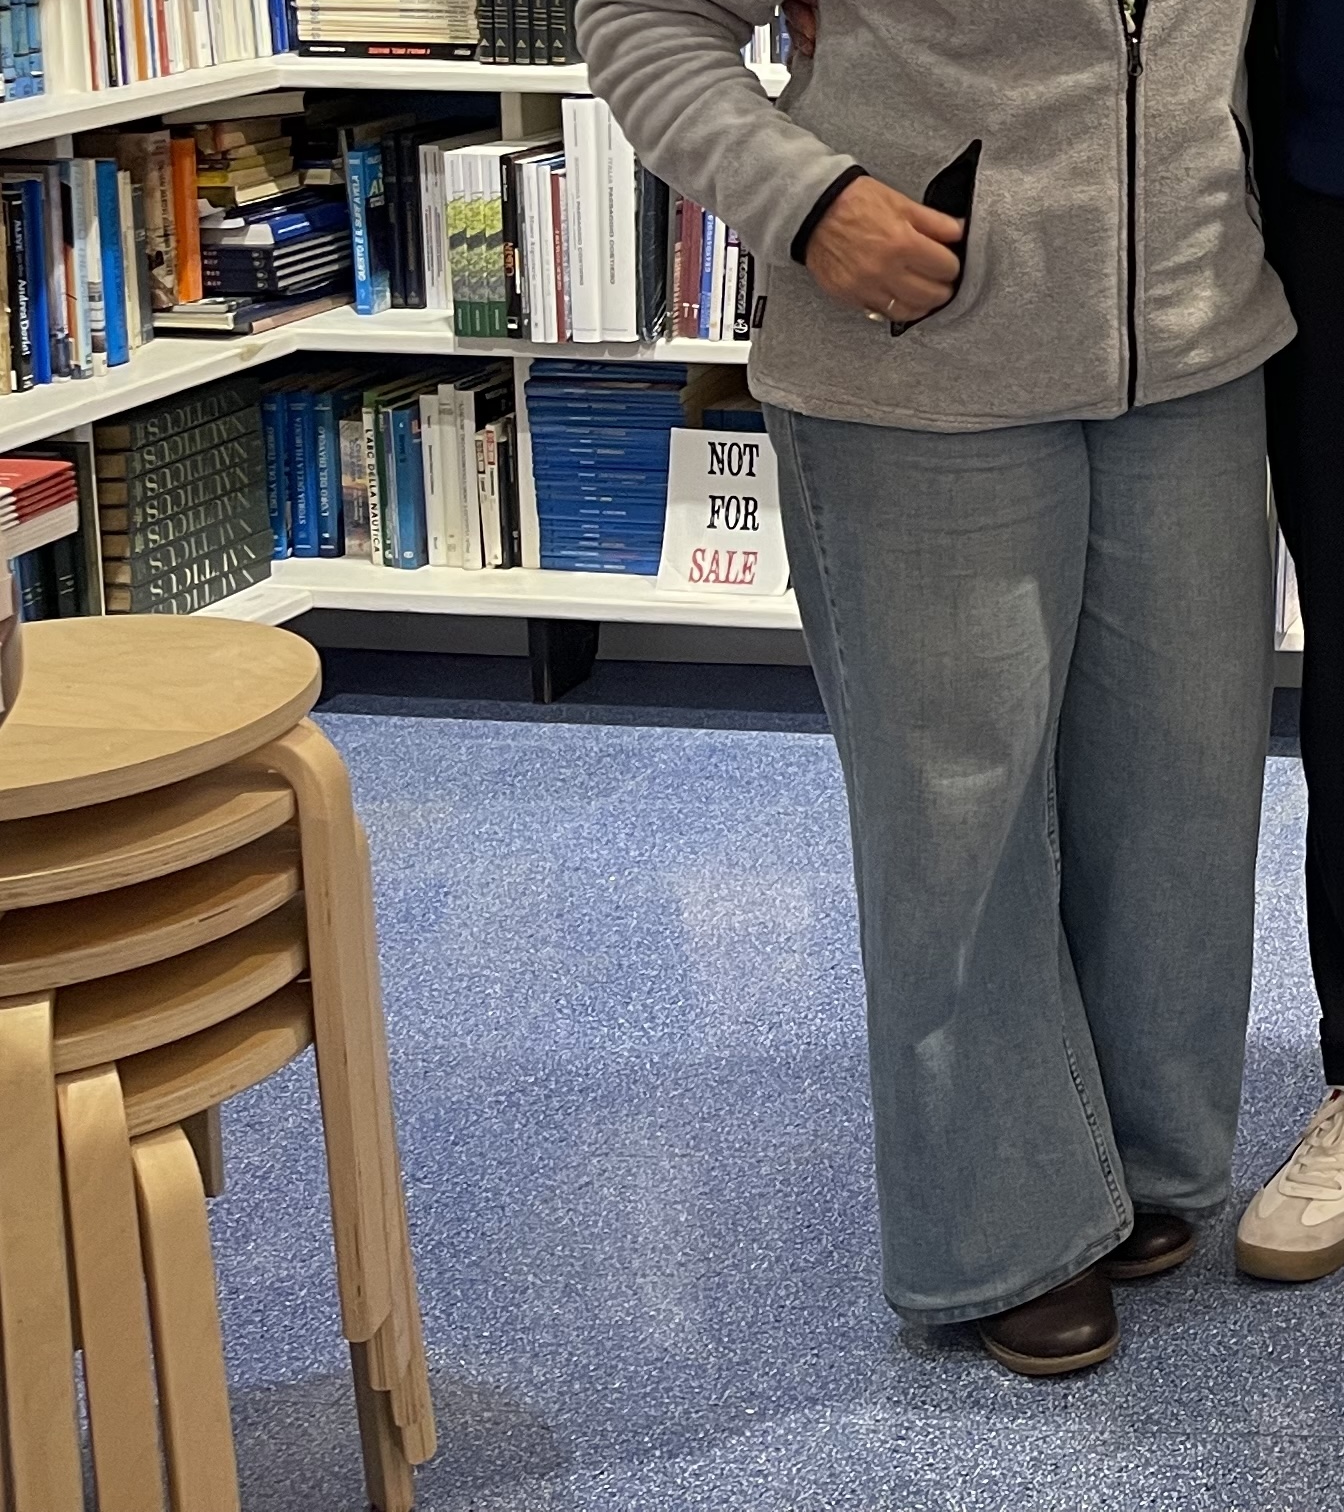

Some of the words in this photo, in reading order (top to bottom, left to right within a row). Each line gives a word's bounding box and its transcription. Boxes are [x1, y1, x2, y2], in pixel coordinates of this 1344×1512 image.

[365, 428, 375, 459] L'ABC
[707, 441, 760, 477] NOT
[367, 461, 377, 497] DELLA
[369, 503, 380, 553] NAUTICA
[706, 495, 760, 531] FOR
[688, 548, 758, 585] SALE
